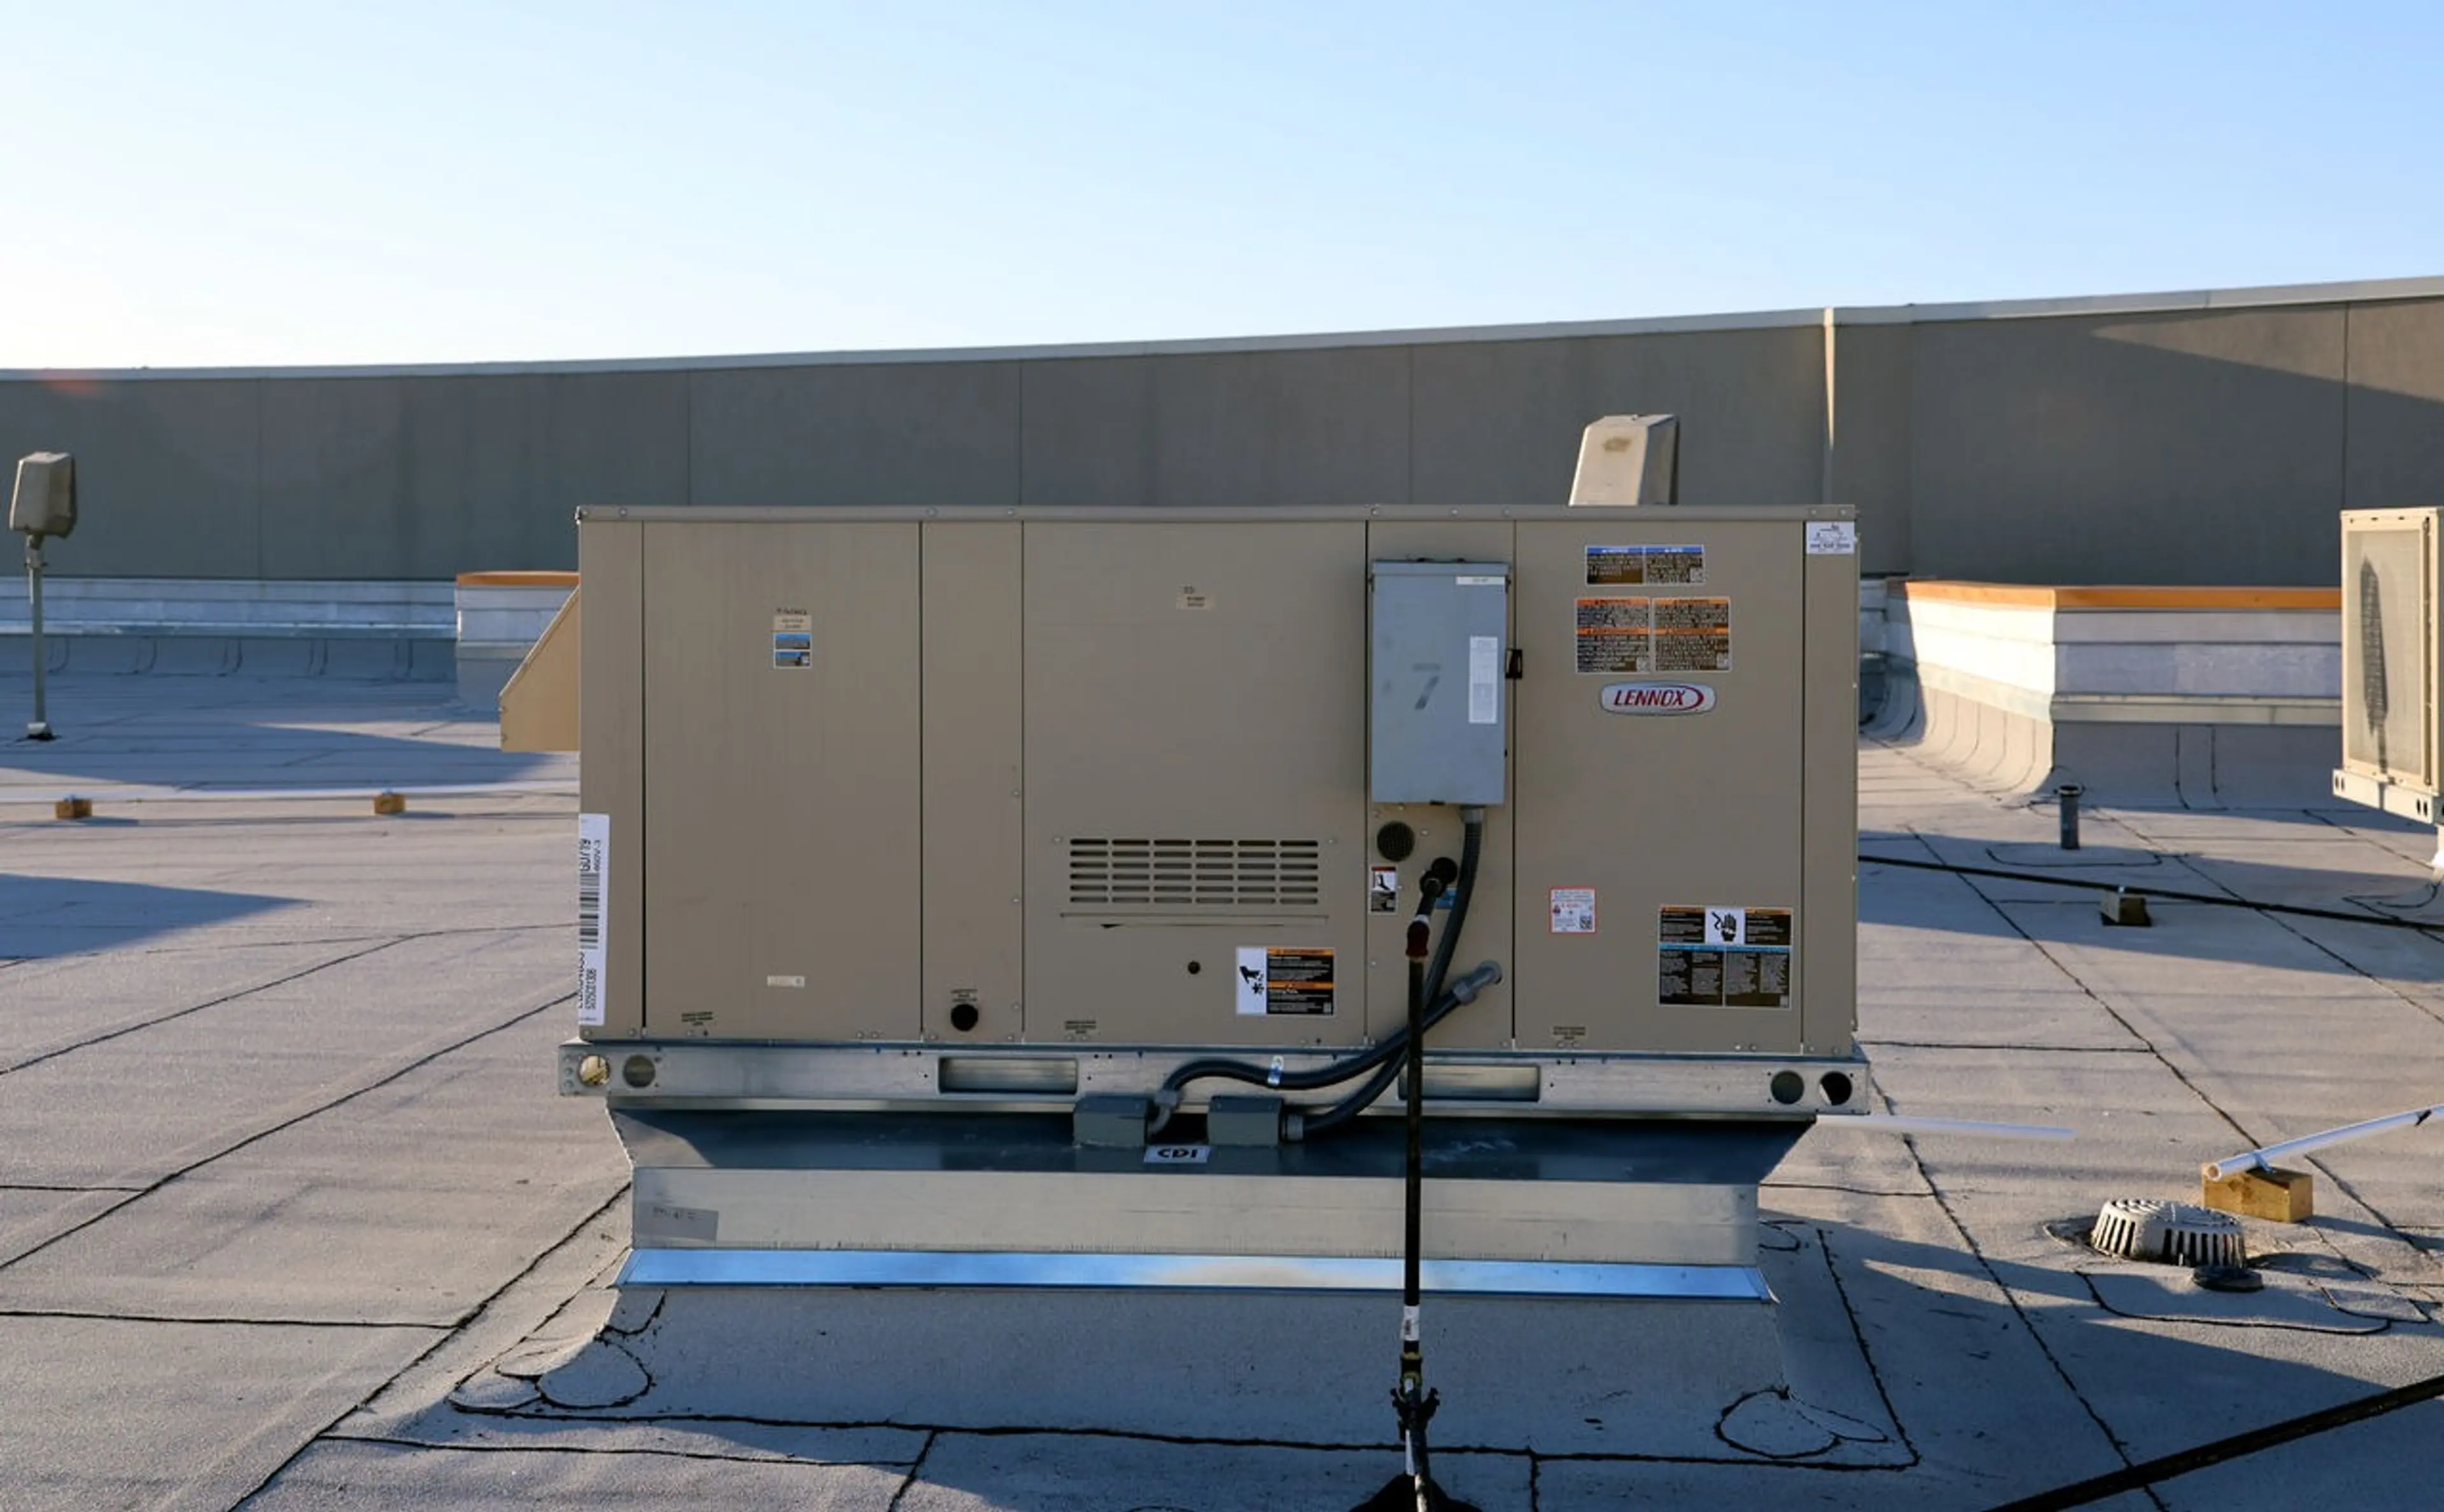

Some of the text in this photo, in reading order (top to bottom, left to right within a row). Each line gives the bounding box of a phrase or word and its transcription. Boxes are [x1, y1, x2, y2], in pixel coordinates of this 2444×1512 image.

[1412, 662, 1441, 710] 7
[1613, 689, 1687, 706] LENNOX
[1157, 1148, 1198, 1158] CDI
